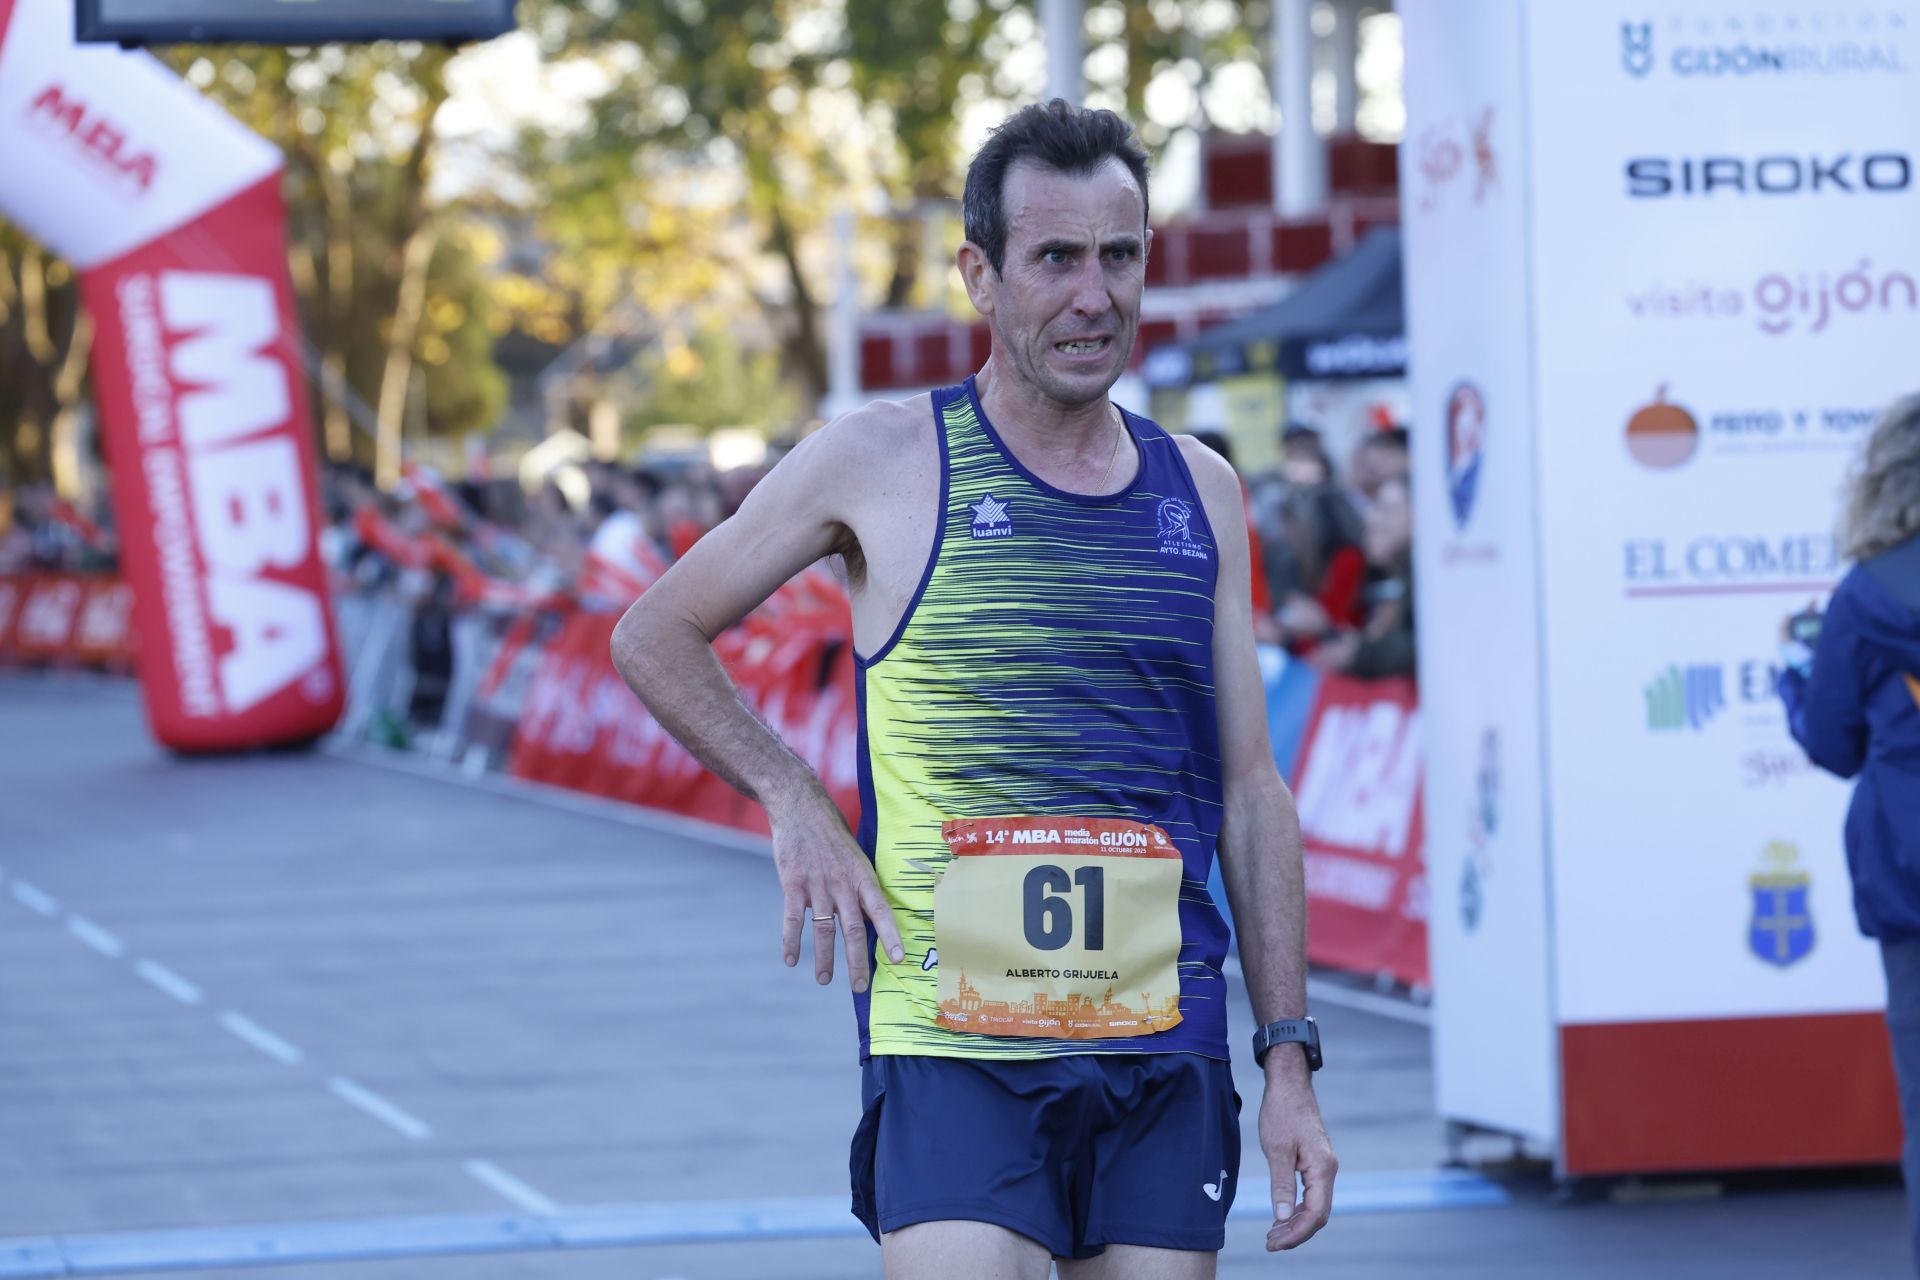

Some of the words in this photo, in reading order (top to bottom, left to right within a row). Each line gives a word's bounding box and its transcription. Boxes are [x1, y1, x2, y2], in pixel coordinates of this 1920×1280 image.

[31, 84, 160, 193] MBA
[1625, 153, 1912, 198] SIROKO
[1626, 280, 1744, 317] visita
[1753, 256, 1919, 336] gijón
[157, 268, 329, 716] MBA
[972, 525, 1012, 539] luanvi
[1163, 539, 1202, 551] ATLETISMO
[1160, 546, 1182, 555] AYTO.
[1182, 548, 1208, 561] BEZANA
[1624, 538, 1680, 579] EL
[1012, 829, 1062, 844] MBA
[1064, 828, 1090, 837] media
[1100, 829, 1148, 847] GIJÓN
[1064, 836, 1099, 845] maratón
[1023, 864, 1104, 951] 61
[1005, 968, 1061, 979] ALBERTO
[1063, 969, 1119, 980] GRIJUELA
[1038, 1018, 1061, 1028] gijón
